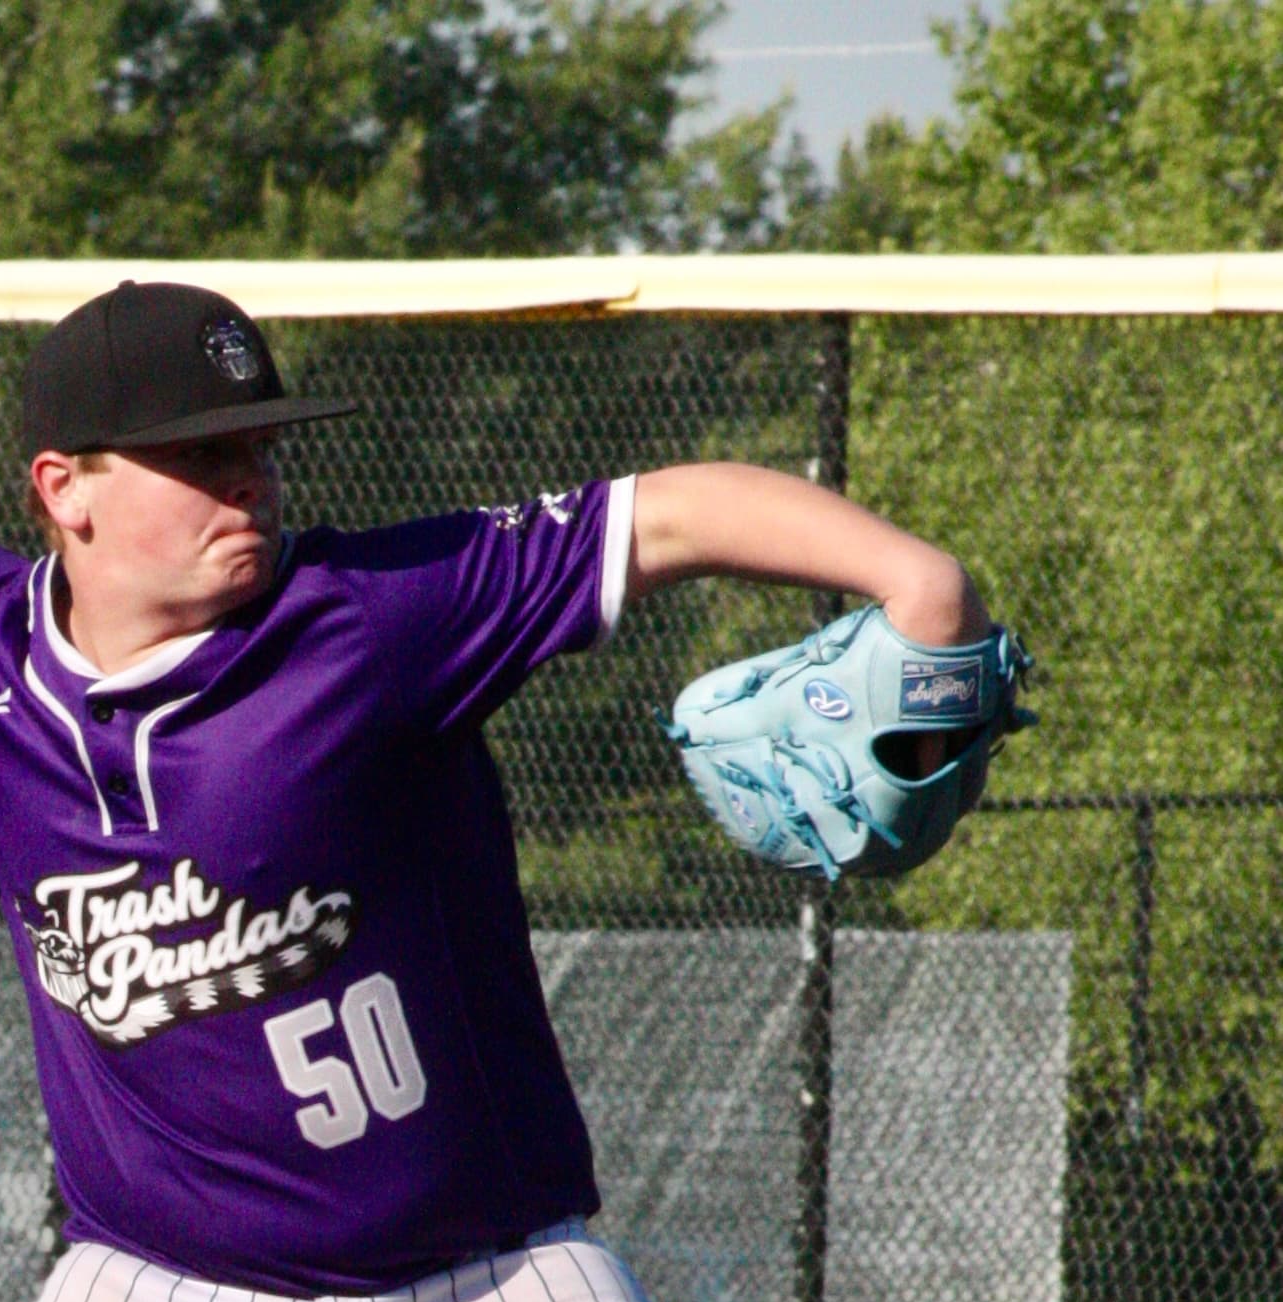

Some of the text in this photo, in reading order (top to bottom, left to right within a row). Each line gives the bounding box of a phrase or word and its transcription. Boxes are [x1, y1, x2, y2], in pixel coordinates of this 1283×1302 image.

[35, 859, 219, 947] Trash
[88, 886, 351, 1022] Pandas
[263, 972, 427, 1149] 50
